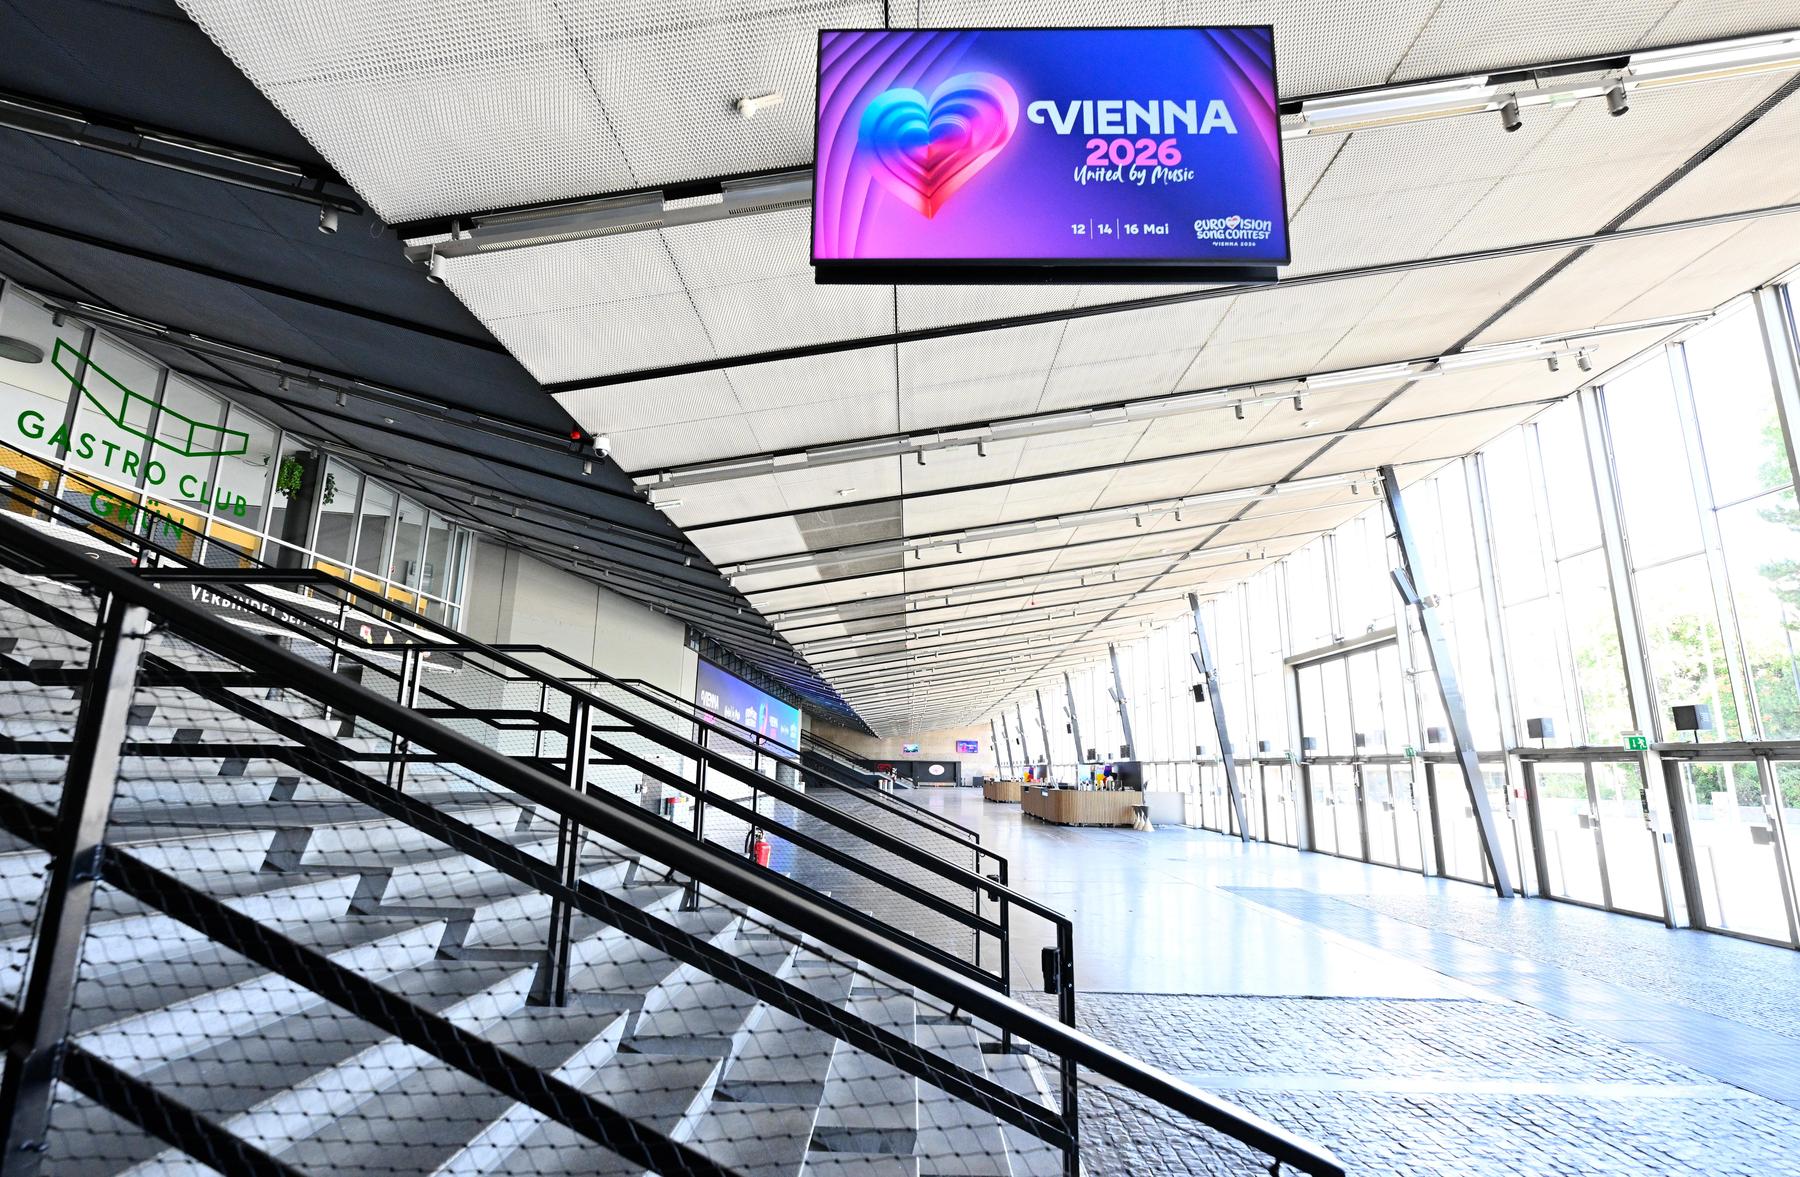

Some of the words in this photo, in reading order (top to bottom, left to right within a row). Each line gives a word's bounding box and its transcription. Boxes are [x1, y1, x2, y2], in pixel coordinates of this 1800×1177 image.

[1027, 100, 1238, 135] VIENNA
[1086, 138, 1182, 167] 2026
[1073, 164, 1124, 186] United
[1128, 163, 1146, 186] by
[1151, 165, 1195, 185] Music
[1071, 223, 1086, 235] 12
[1097, 223, 1113, 235] 14
[1124, 223, 1139, 235] 16
[1143, 222, 1169, 235] Mai
[17, 410, 166, 486] GASTRO
[179, 474, 248, 518] CLUB
